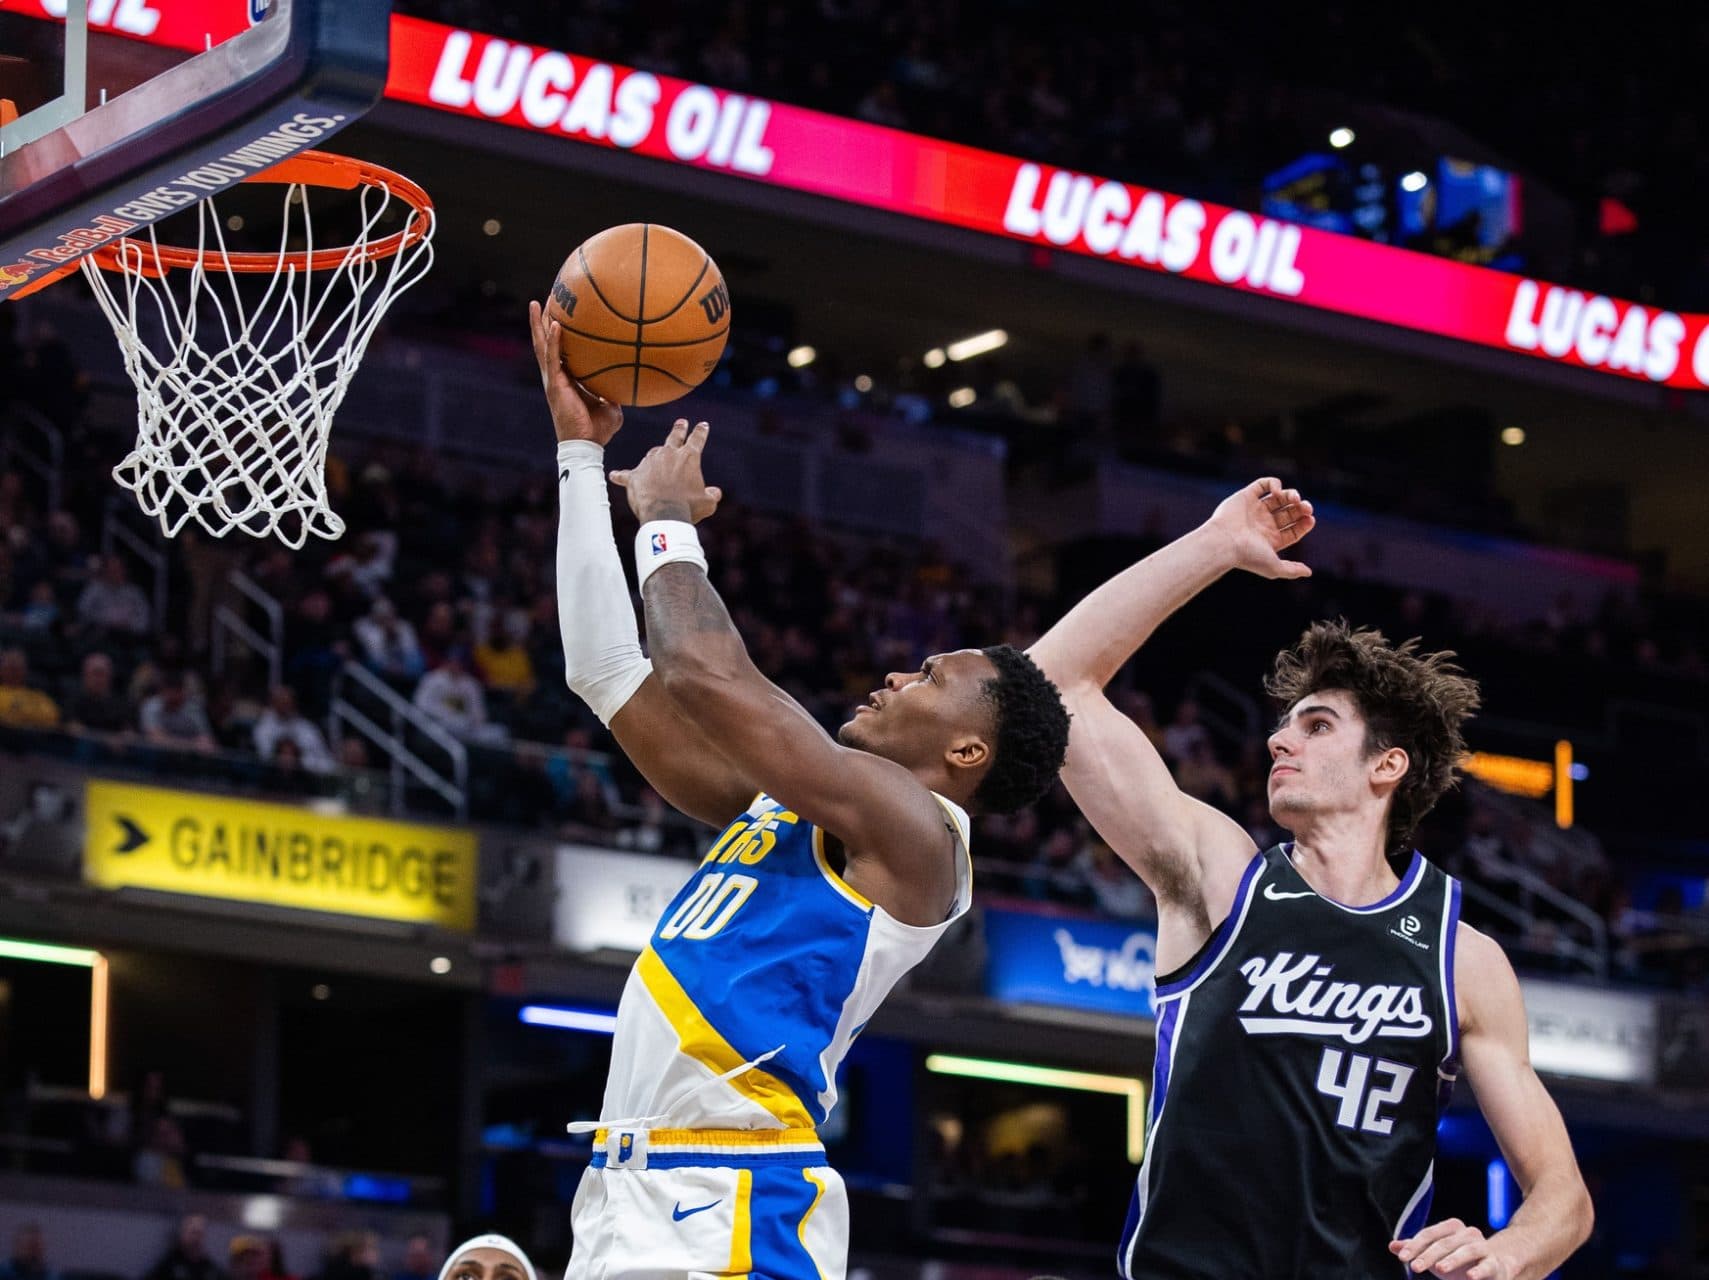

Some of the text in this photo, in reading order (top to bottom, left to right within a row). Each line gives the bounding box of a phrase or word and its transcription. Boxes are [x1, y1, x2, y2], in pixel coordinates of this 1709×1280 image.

[428, 31, 774, 175] LUCAS OIL
[113, 186, 198, 220] GIVES
[168, 162, 246, 190] YOU
[1003, 162, 1305, 296] LUCAS OIL
[1505, 279, 1686, 382] LUCAS
[168, 816, 458, 906] GAINBRIDGE
[659, 871, 760, 940] 00
[1239, 951, 1433, 1044] Kings
[1315, 1046, 1417, 1136] 42
